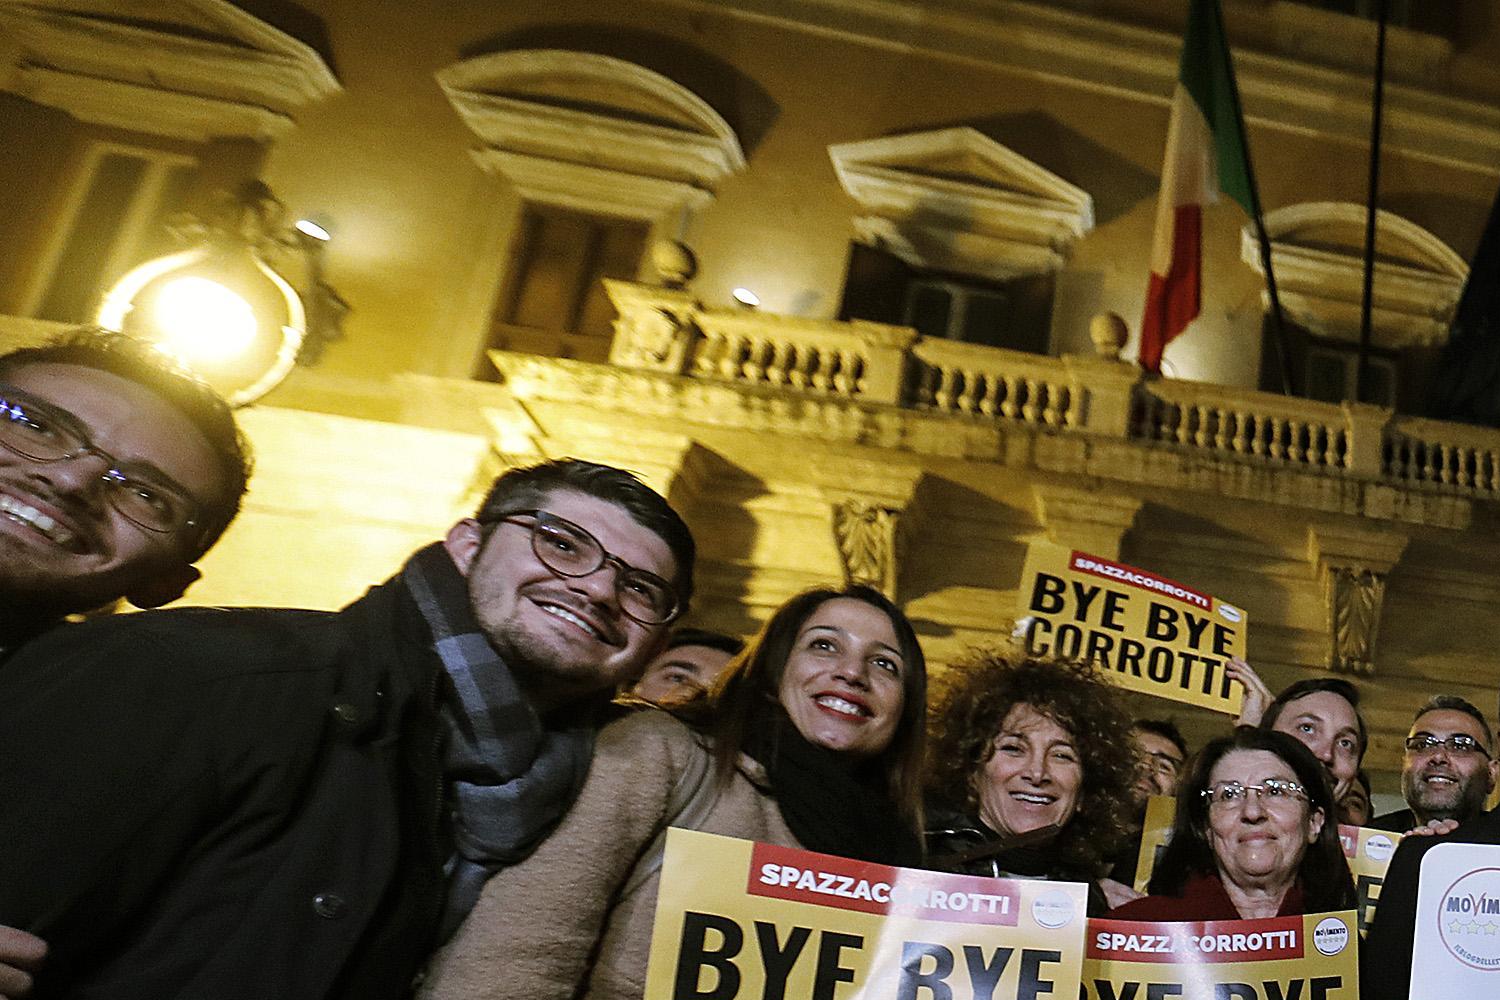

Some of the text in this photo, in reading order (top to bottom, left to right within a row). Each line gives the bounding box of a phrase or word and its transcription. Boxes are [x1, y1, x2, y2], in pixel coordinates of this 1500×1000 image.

[1030, 572, 1236, 659] BYE BYE
[1075, 557, 1209, 607] SPAZZACORROTTI
[1024, 616, 1237, 700] CORROTTI
